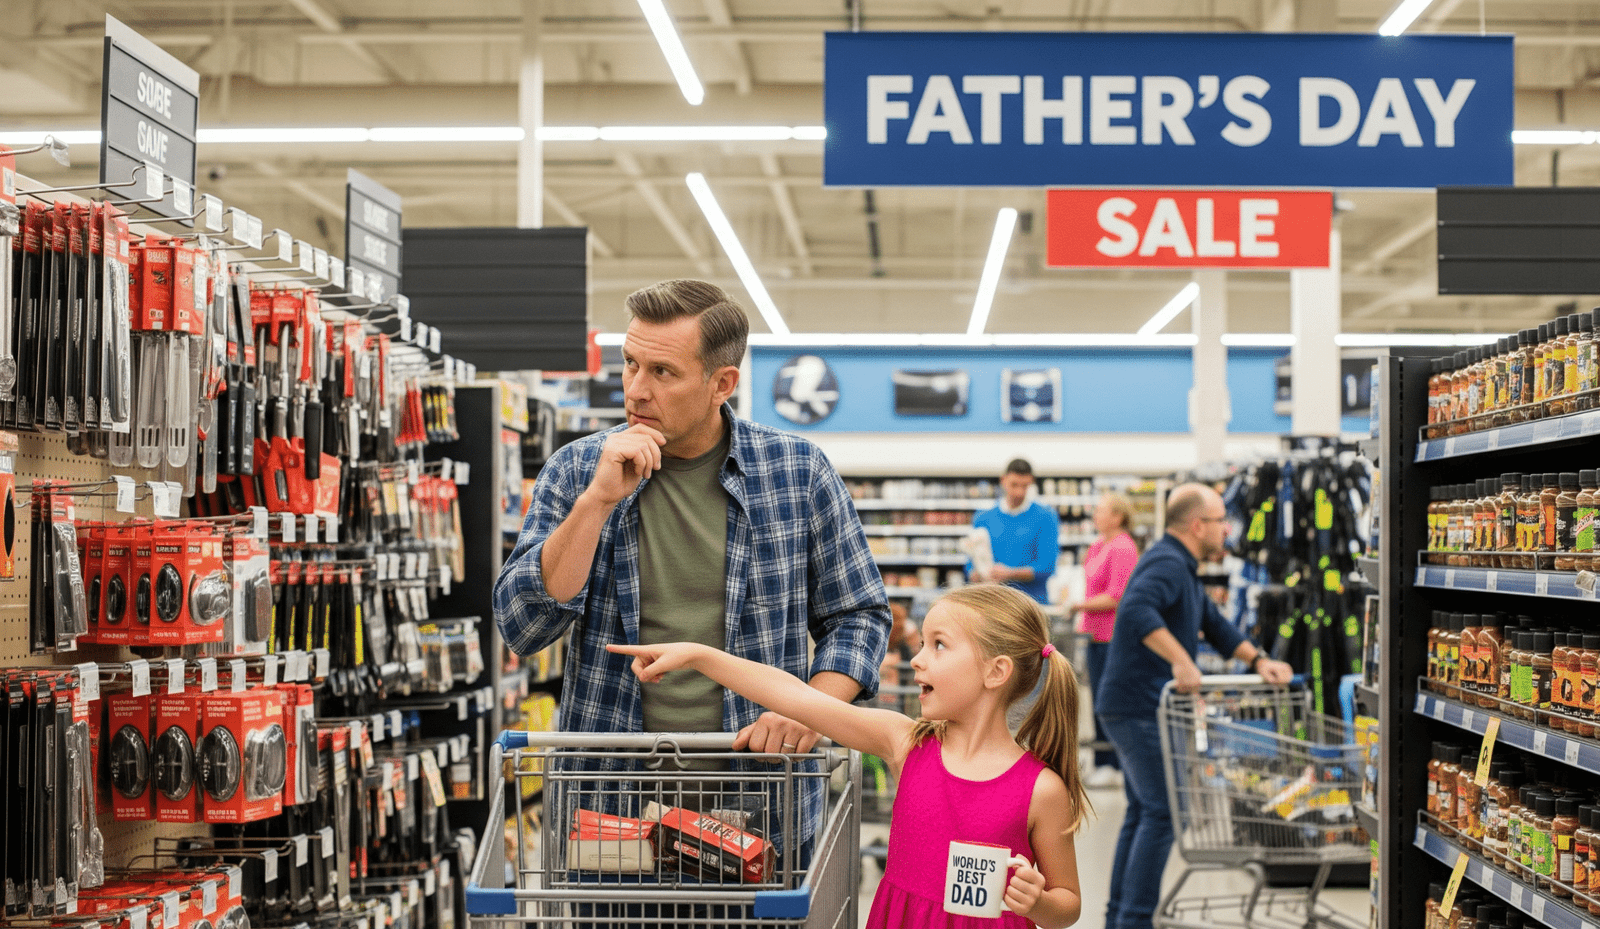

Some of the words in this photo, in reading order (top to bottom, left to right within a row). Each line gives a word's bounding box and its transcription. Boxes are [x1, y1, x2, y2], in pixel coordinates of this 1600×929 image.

[867, 75, 1271, 146] FATHER'S
[1299, 77, 1476, 147] DAY
[1096, 198, 1280, 258] SALE
[952, 854, 996, 873] WORLD'S
[957, 869, 986, 886] BEST
[951, 883, 988, 907] DAD
